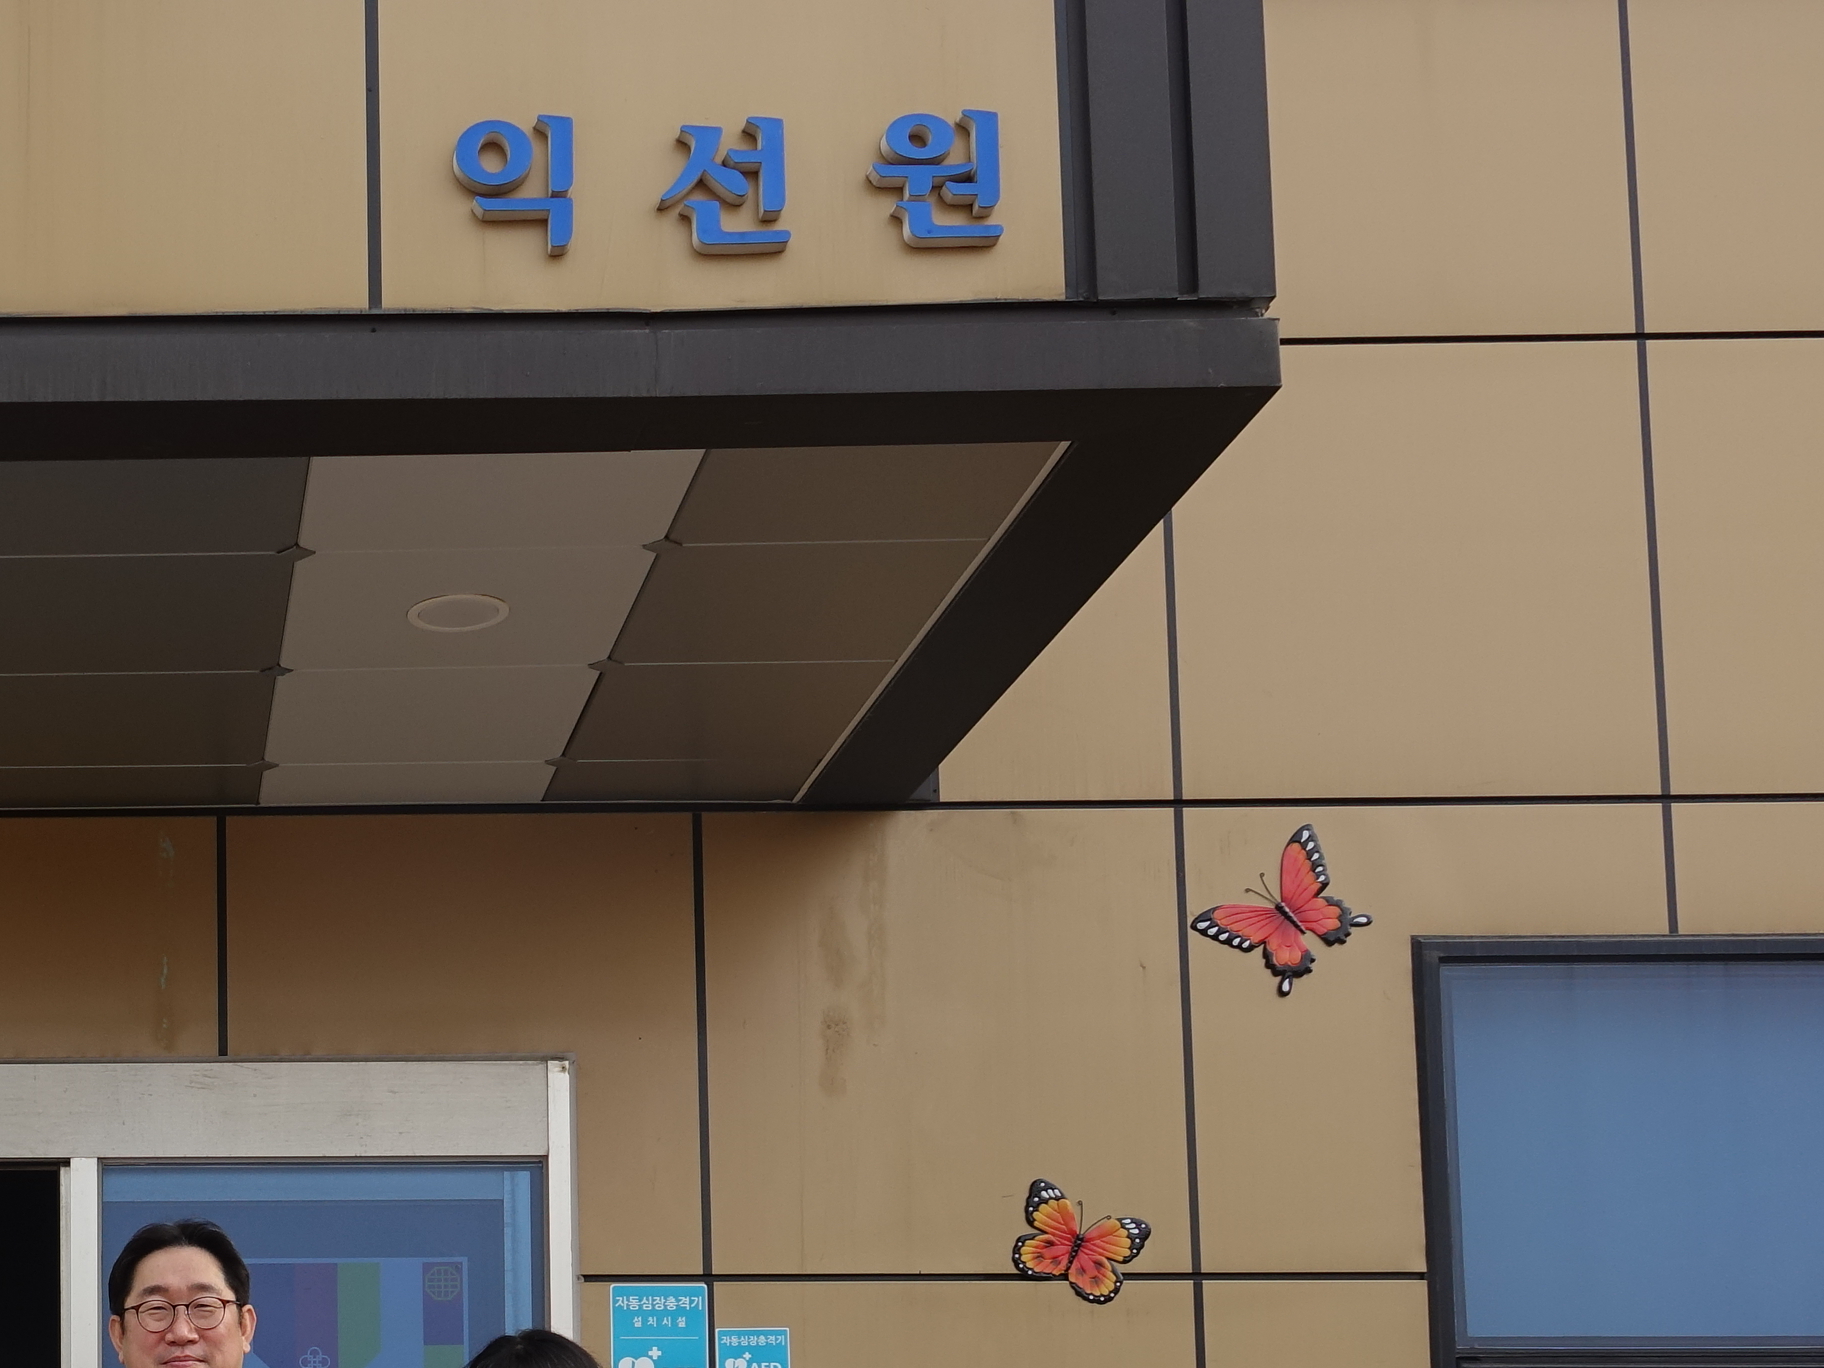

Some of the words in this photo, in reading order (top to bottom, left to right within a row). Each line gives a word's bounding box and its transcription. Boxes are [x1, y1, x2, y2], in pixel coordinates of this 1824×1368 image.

[452, 108, 1004, 257] 익선원
[615, 1296, 703, 1310] 자동심장충격기
[632, 1316, 687, 1328] 설치시설
[720, 1335, 785, 1346] 자동심장충격기
